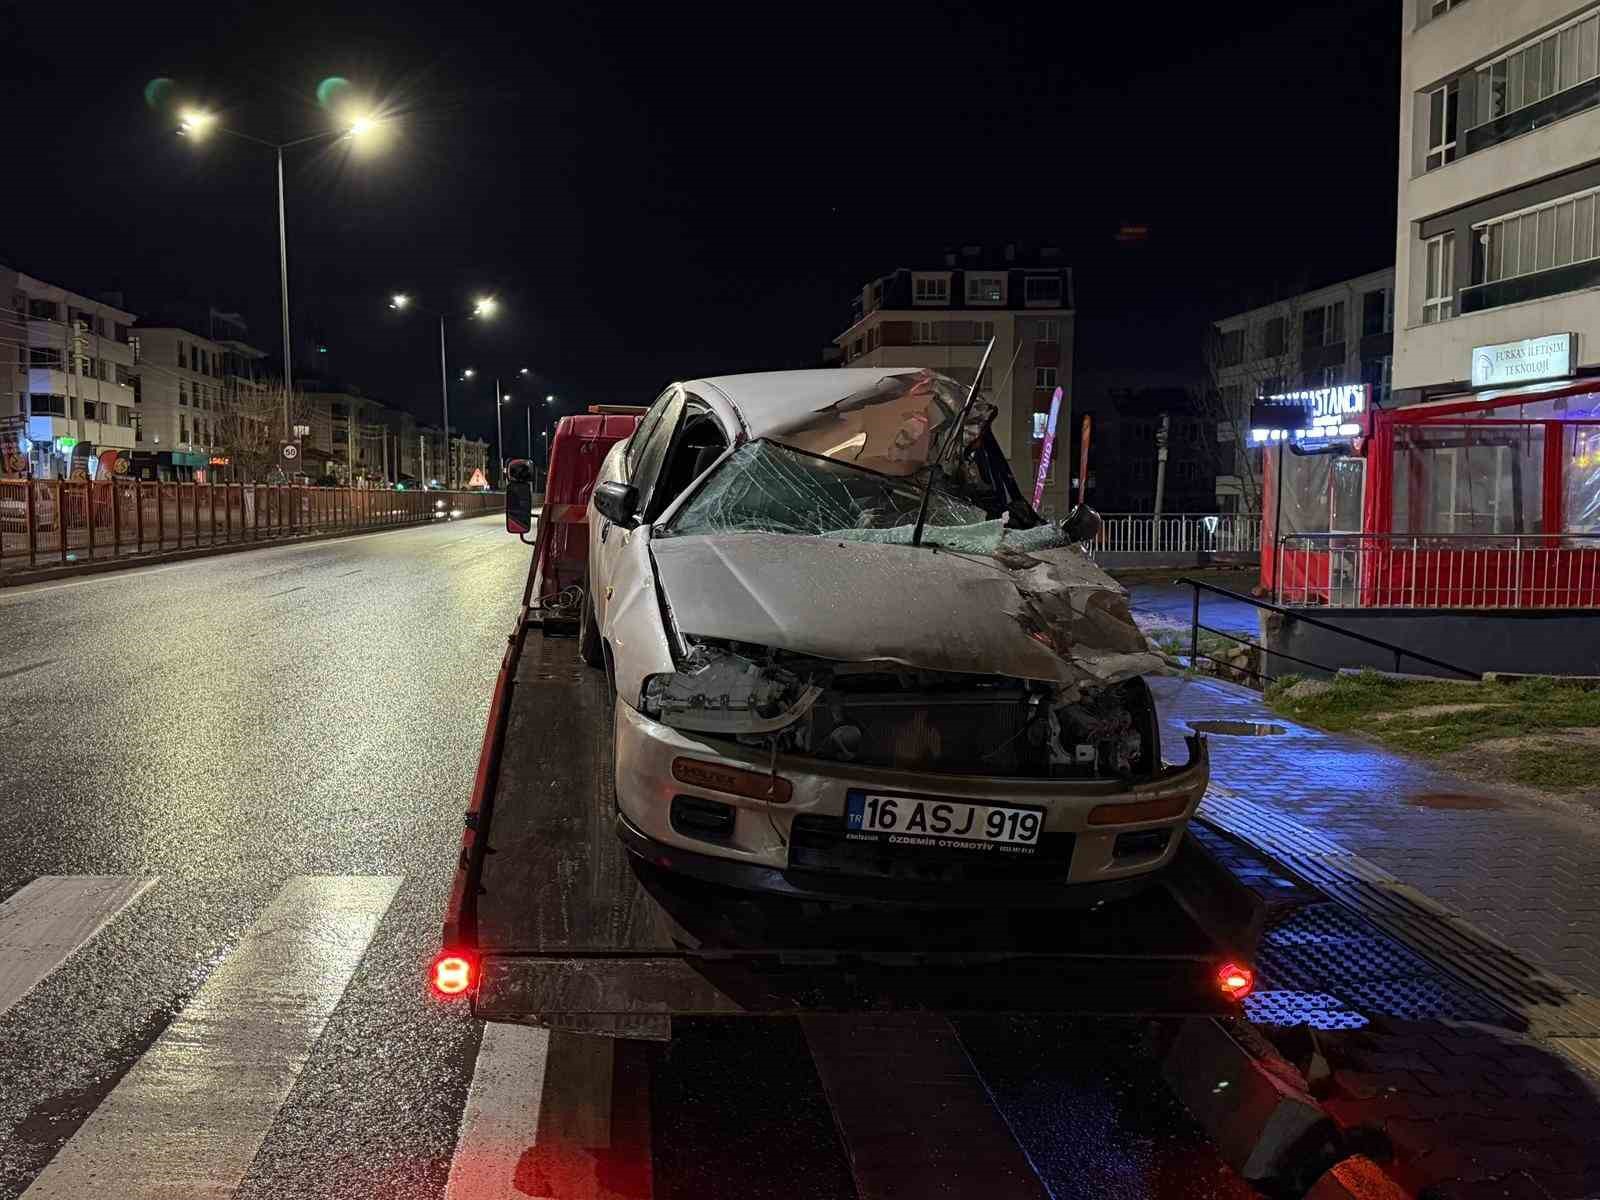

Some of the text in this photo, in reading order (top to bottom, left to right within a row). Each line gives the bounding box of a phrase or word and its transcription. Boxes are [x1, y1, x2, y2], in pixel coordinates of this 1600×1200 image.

[849, 798, 1039, 841] TR 16 ASJ 919
[888, 835, 936, 848] ÖZDEMİR
[939, 840, 993, 852] OTOMOTİV
